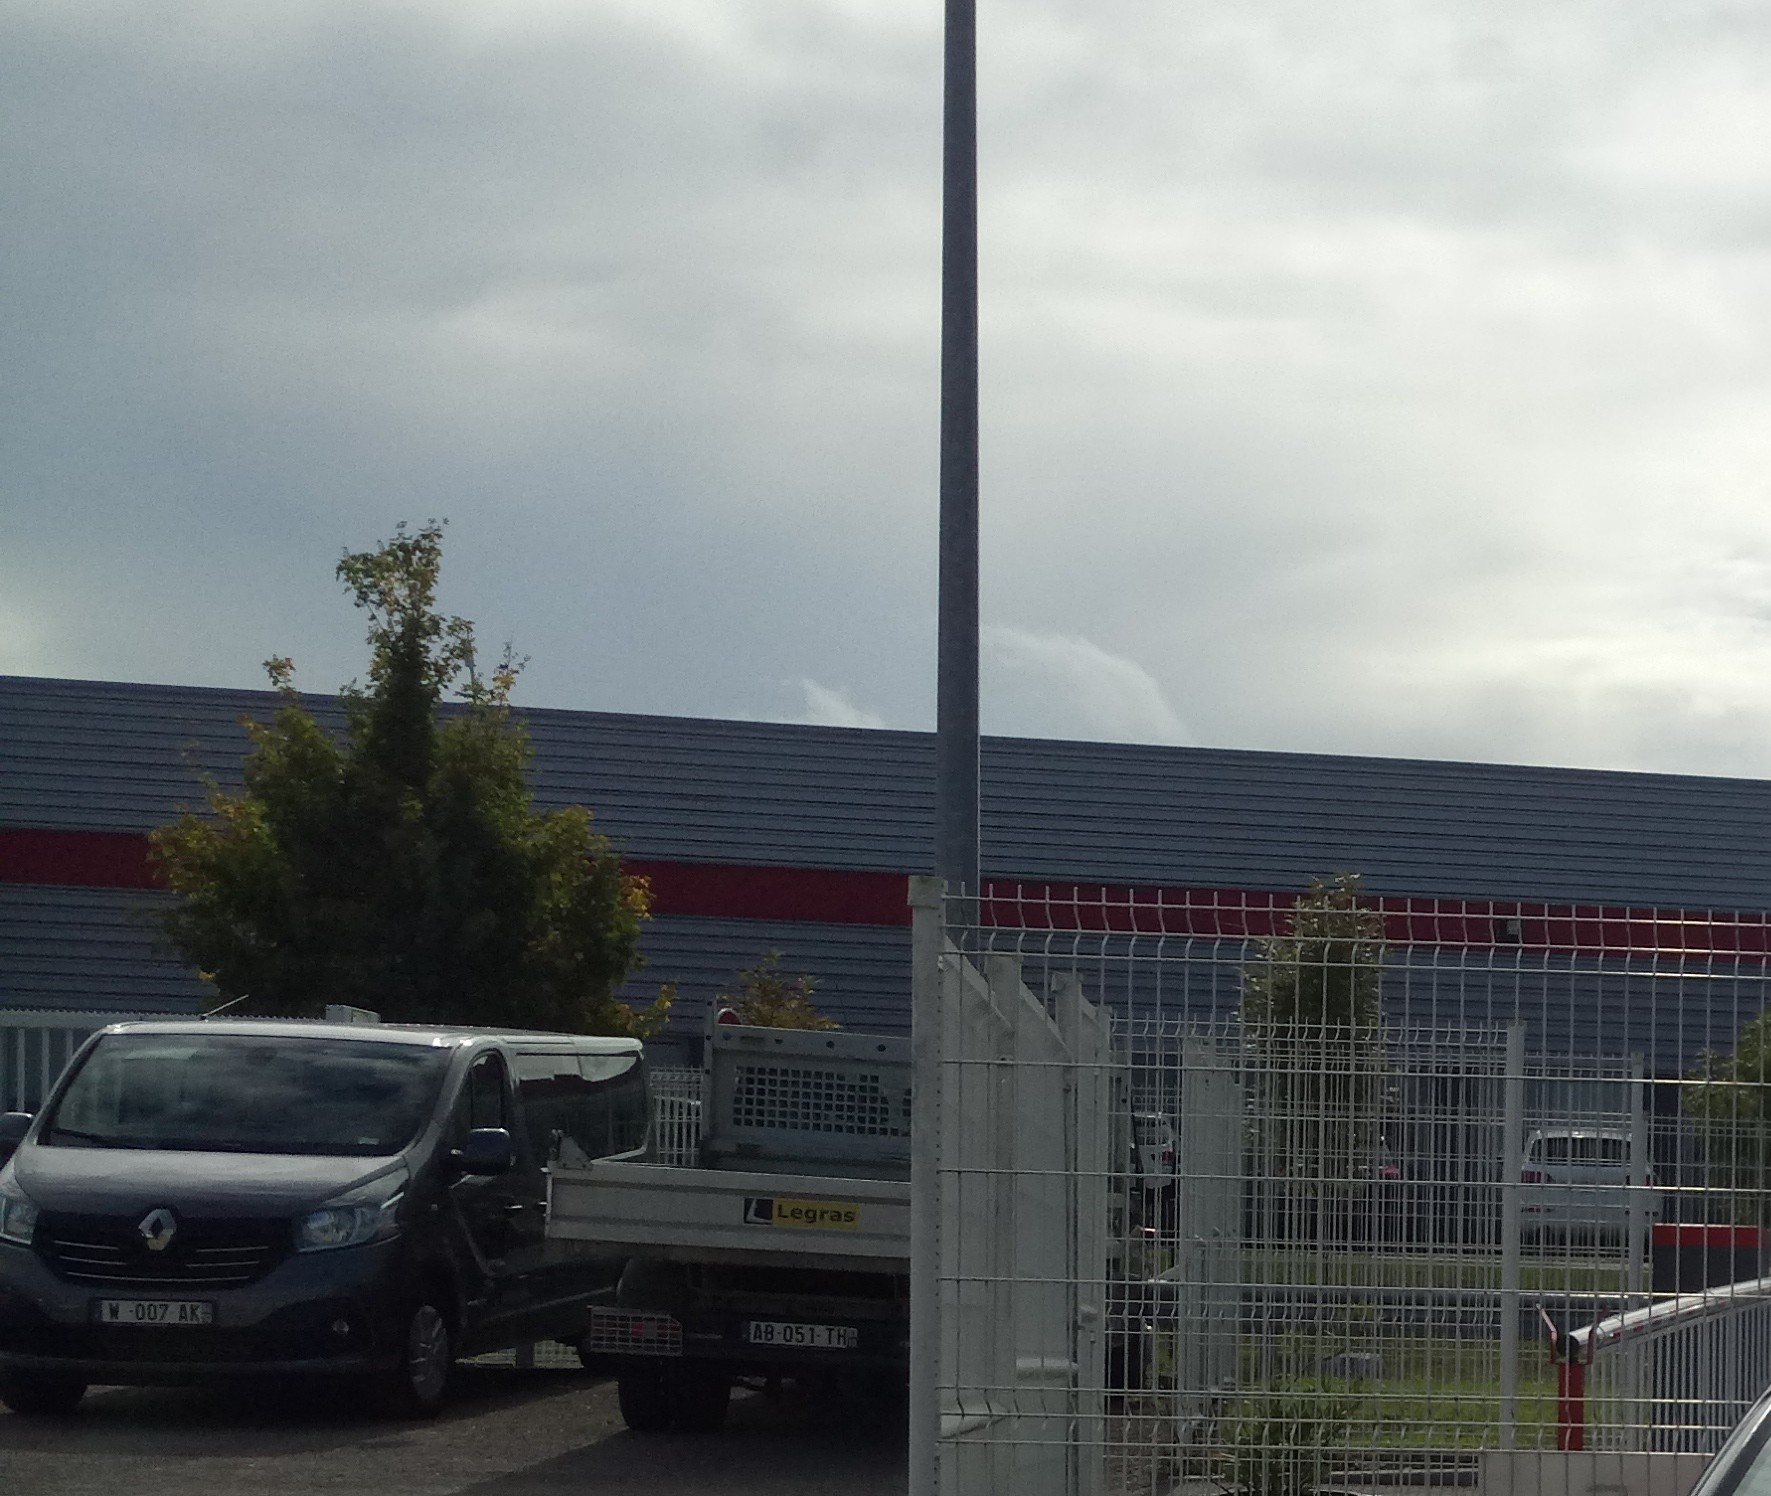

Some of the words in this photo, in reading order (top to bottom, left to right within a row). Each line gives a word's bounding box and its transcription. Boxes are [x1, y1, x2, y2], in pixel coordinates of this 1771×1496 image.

[777, 1204, 857, 1224] Legras
[178, 1303, 201, 1322] AK
[753, 1323, 848, 1346] AB-051-TH
